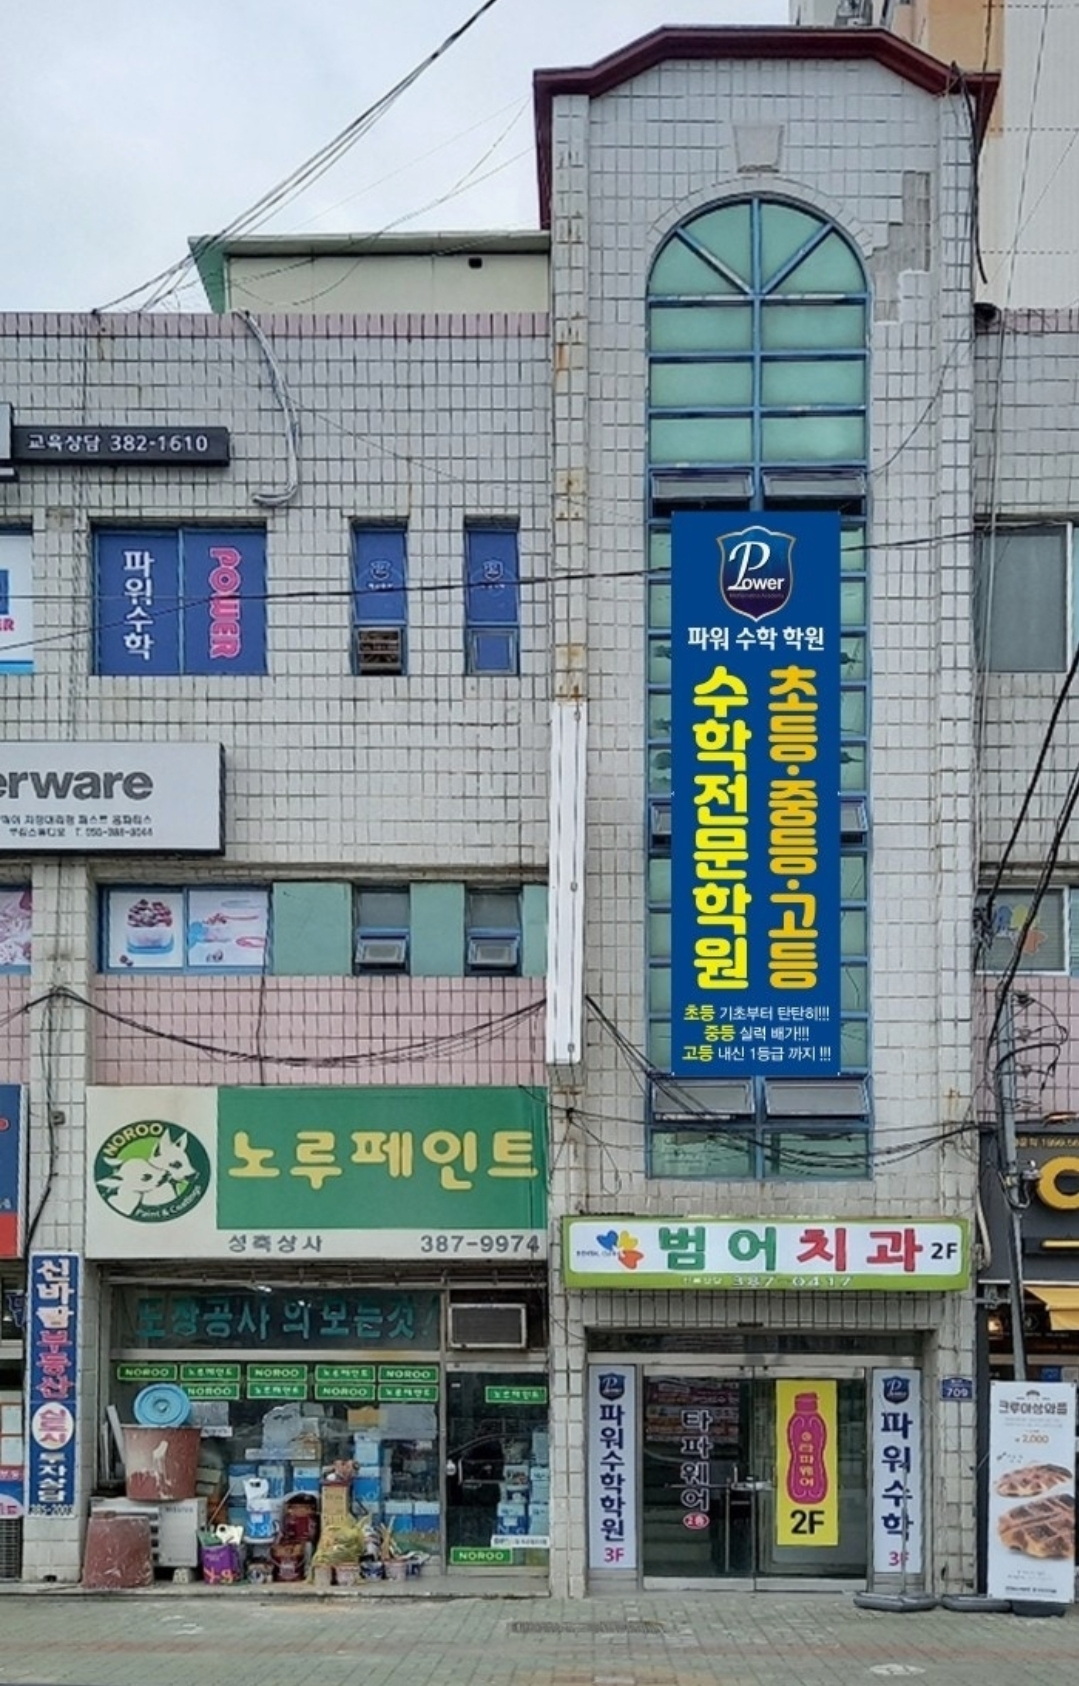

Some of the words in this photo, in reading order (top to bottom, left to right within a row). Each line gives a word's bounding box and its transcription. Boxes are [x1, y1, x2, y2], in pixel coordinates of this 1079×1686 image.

[28, 434, 101, 452] 교육상담
[110, 434, 208, 451] 382-1610
[123, 551, 154, 661] 파워수학
[209, 547, 241, 658] POWER
[688, 628, 729, 650] 파워
[736, 628, 777, 650] 수학
[783, 628, 824, 650] 학원
[0, 771, 153, 800] rware
[693, 665, 752, 990] 수학전문학원
[684, 1005, 715, 1021] 초등
[720, 1006, 773, 1021] 기초부터
[777, 1006, 830, 1021] 탄탄히!!!
[704, 1025, 736, 1041] 중등
[740, 1027, 766, 1041] 실력
[771, 1027, 810, 1041] 배가!!!
[682, 1045, 714, 1061] 고등
[718, 1047, 744, 1061] 내신
[751, 1047, 784, 1061] 1등급
[788, 1047, 815, 1061] 까지
[103, 1123, 163, 1156] NOROO
[228, 1131, 539, 1190] 노루페인트
[421, 1235, 540, 1253] 387-9974
[658, 1226, 923, 1272] 범어치과
[931, 1242, 957, 1259] 2F
[283, 1301, 309, 1339] 의
[125, 1368, 169, 1376] NOROO
[255, 1368, 299, 1377] NOROO
[386, 1370, 431, 1379] NOROO
[188, 1387, 231, 1396] NOROO
[323, 1387, 368, 1396] NOROO
[600, 1404, 626, 1542] 파워수학학원
[881, 1412, 914, 1541] 파워수학
[790, 1510, 825, 1535] 2F
[459, 1552, 504, 1561] NOROO
[604, 1548, 624, 1562] 3F
